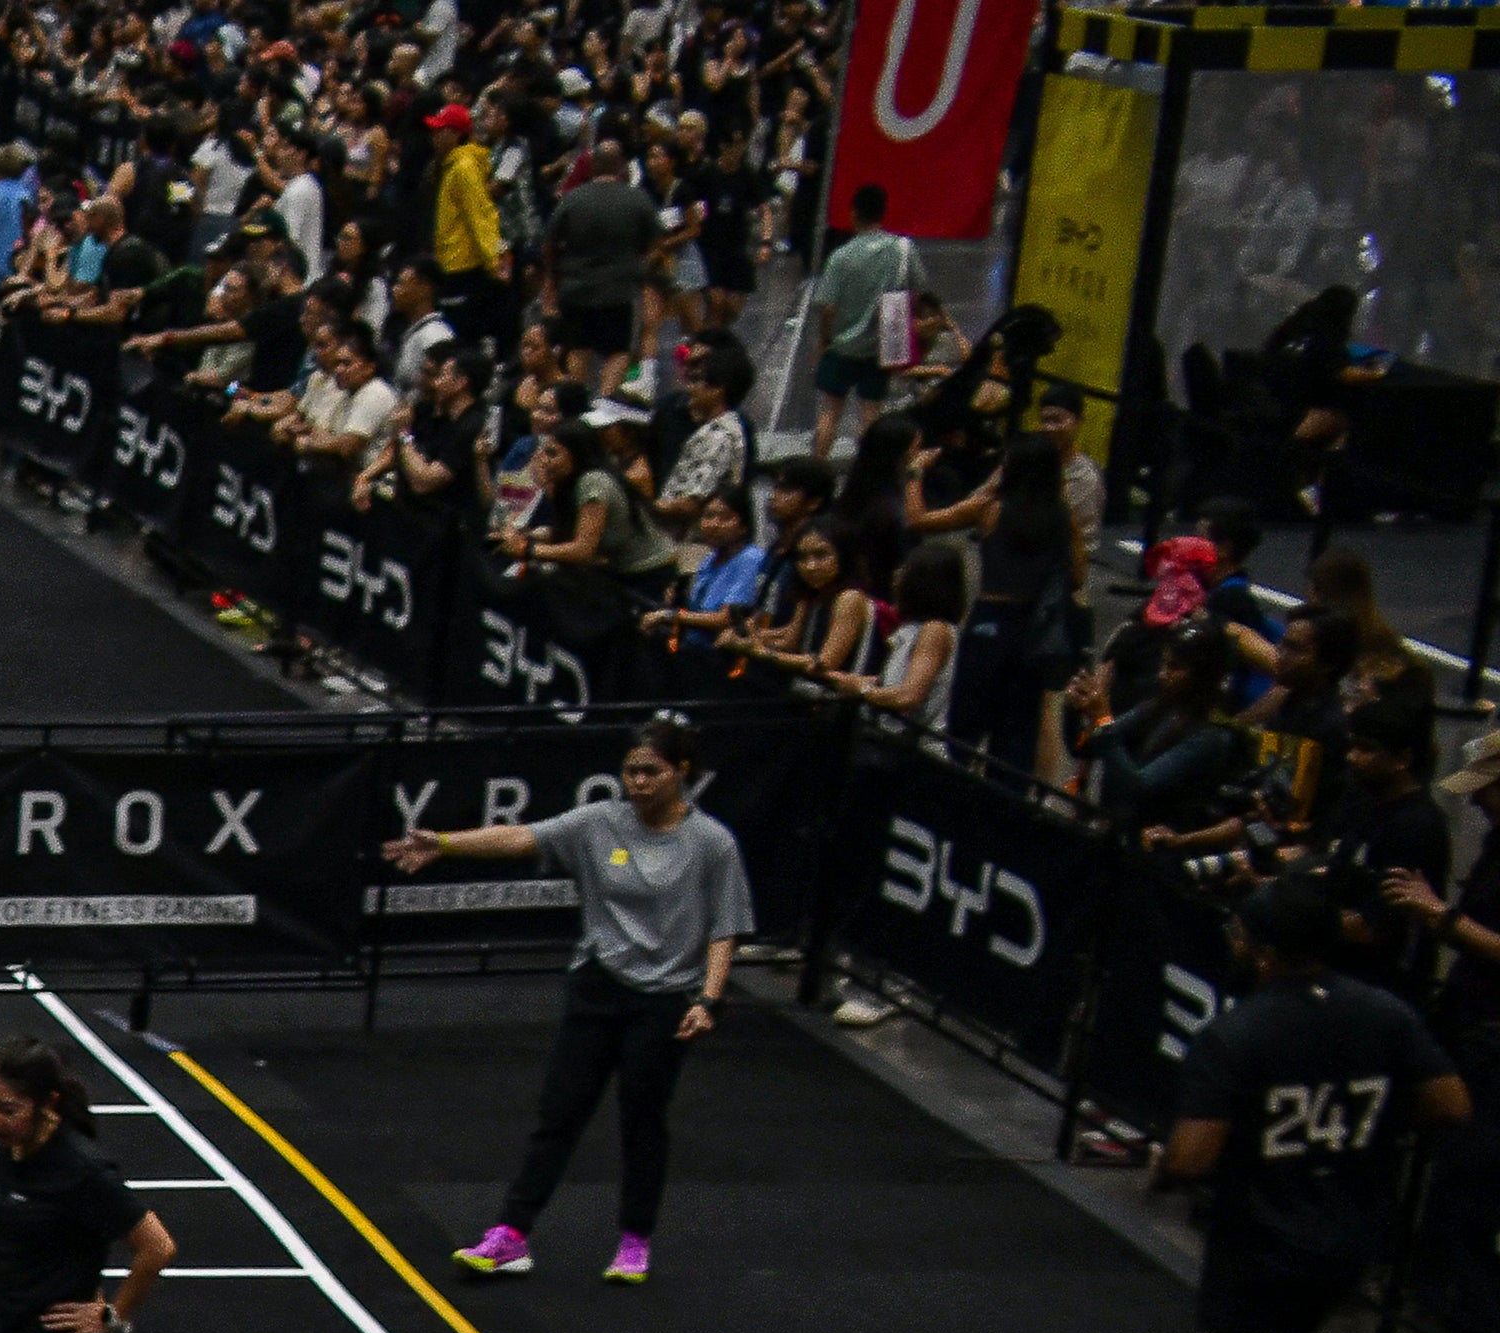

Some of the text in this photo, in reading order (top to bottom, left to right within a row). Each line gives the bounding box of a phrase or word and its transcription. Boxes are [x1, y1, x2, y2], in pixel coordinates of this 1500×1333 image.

[20, 358, 90, 432] BYD
[115, 406, 184, 488] BYD
[213, 464, 276, 552] BYD
[321, 531, 412, 629] BYD
[481, 610, 589, 724] BYD
[882, 817, 1044, 967] BYD
[1263, 1075, 1391, 1159] 247
